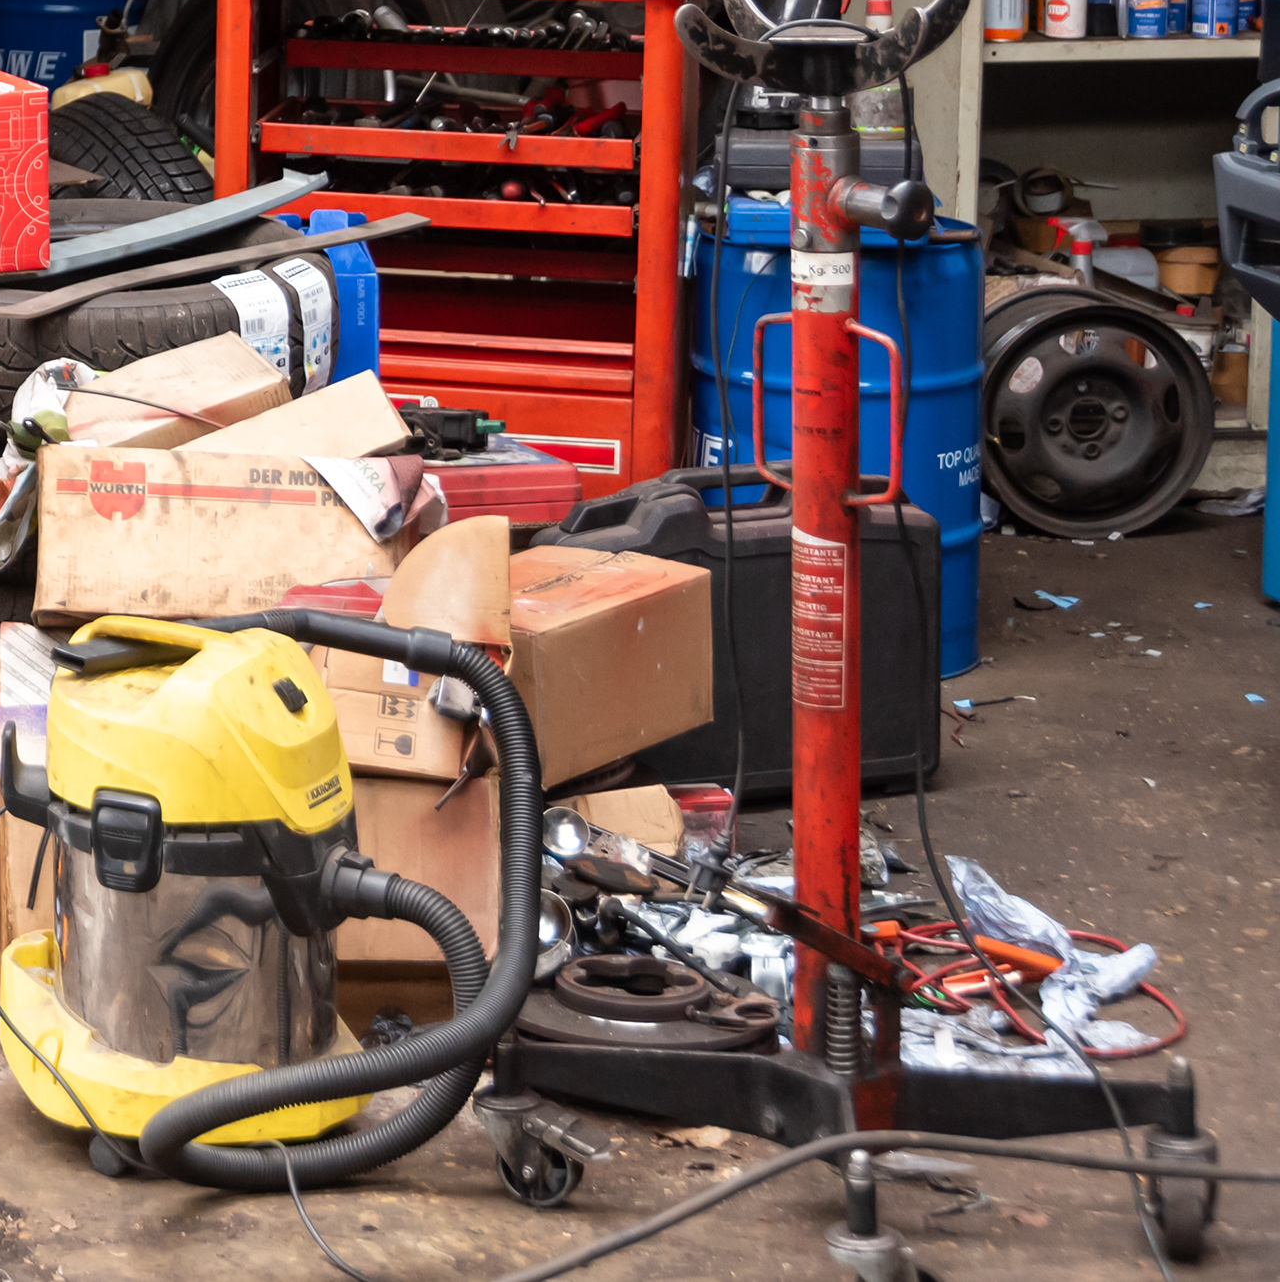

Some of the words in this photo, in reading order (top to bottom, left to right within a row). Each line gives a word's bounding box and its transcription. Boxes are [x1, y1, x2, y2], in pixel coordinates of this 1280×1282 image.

[831, 264, 851, 274] 500
[937, 450, 962, 470] TOP
[249, 468, 282, 485] DER
[352, 458, 387, 494] EKRA
[90, 482, 146, 495] WÜRTH
